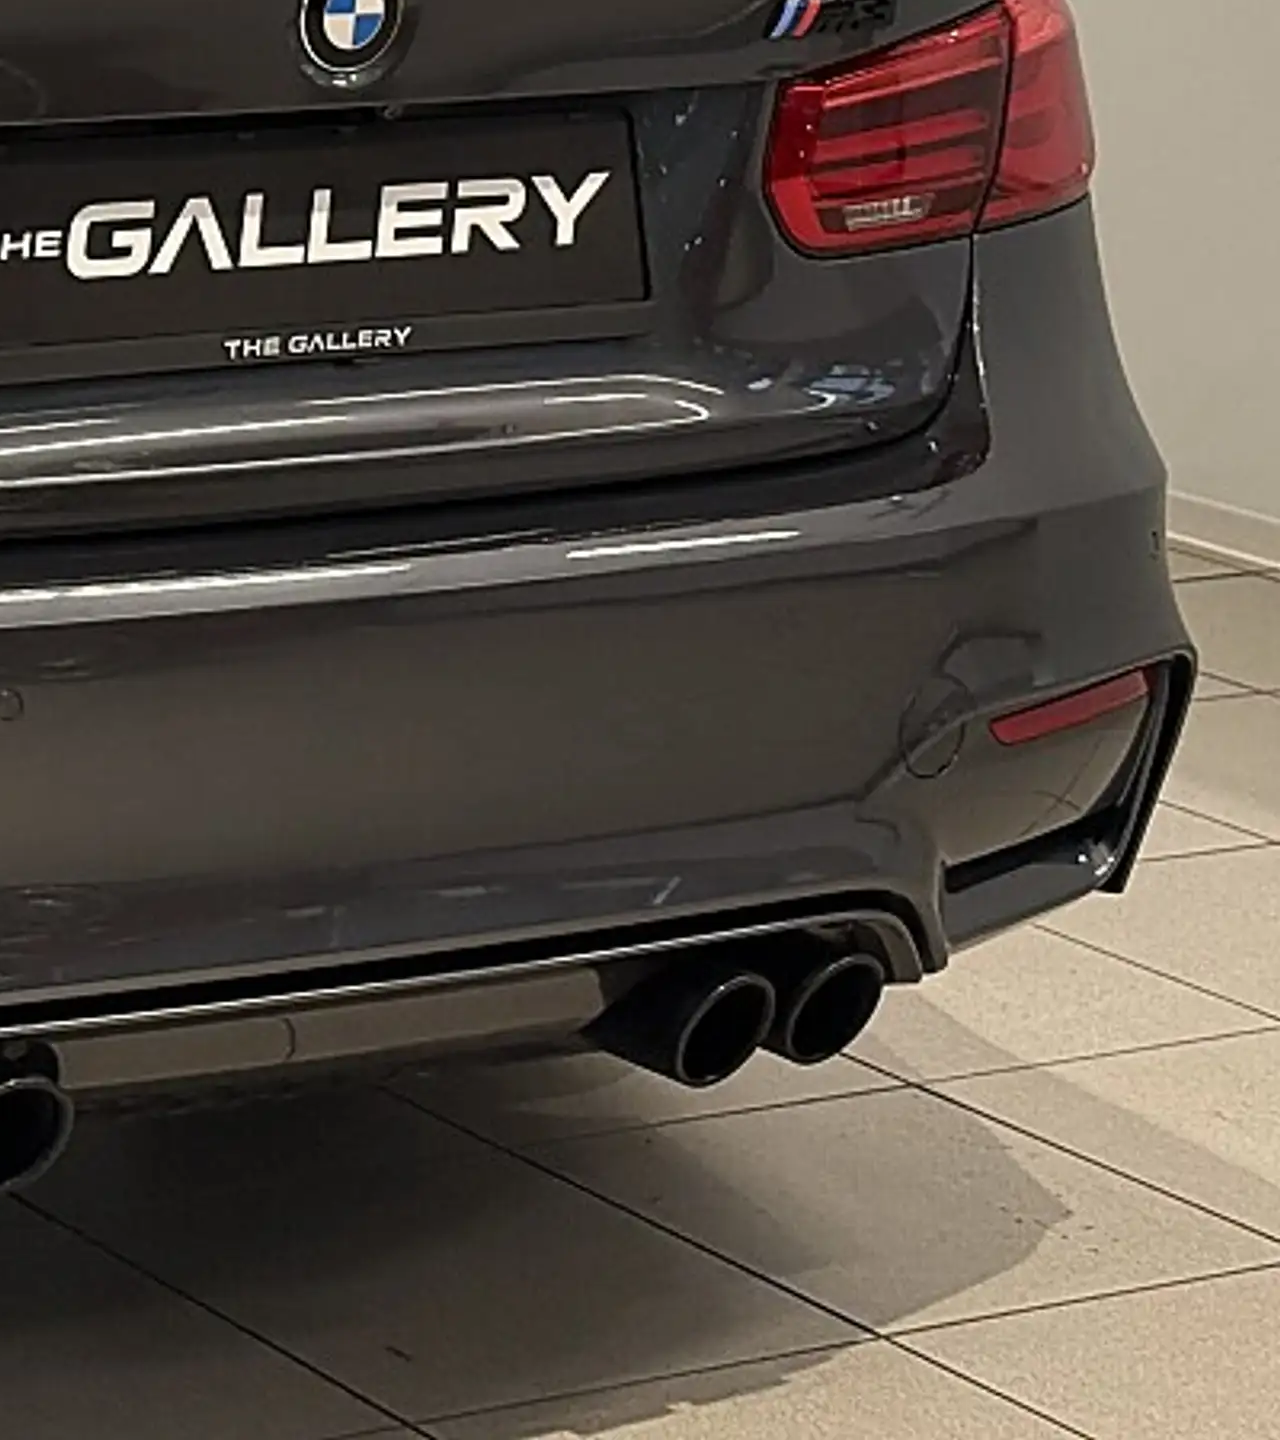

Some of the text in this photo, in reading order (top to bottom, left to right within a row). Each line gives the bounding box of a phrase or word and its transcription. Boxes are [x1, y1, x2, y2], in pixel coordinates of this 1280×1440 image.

[66, 171, 611, 280] GALLERY
[223, 325, 413, 361] THE GALLERY
